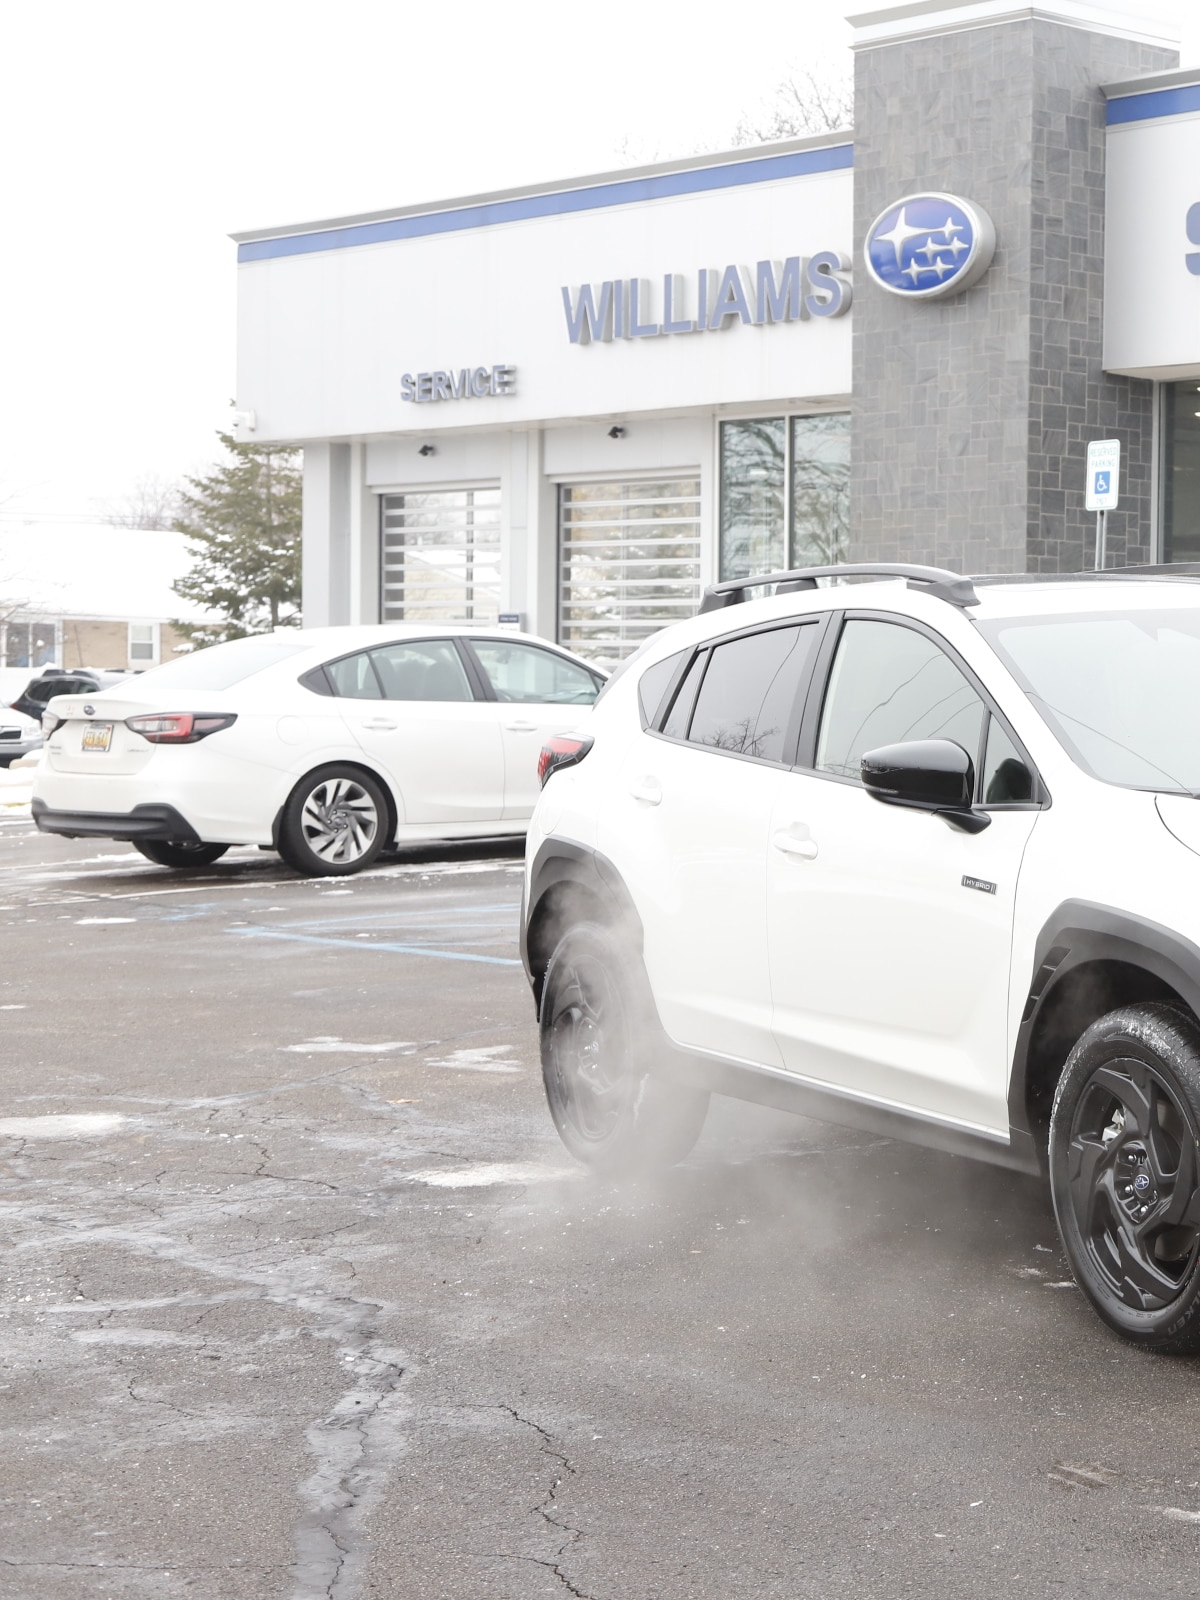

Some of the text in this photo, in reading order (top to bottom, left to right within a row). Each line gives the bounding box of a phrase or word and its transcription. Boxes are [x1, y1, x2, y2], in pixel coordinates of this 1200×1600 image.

[560, 250, 852, 345] WILLIAMS
[400, 364, 517, 402] SERVICE
[966, 879, 990, 890] HYBRID
